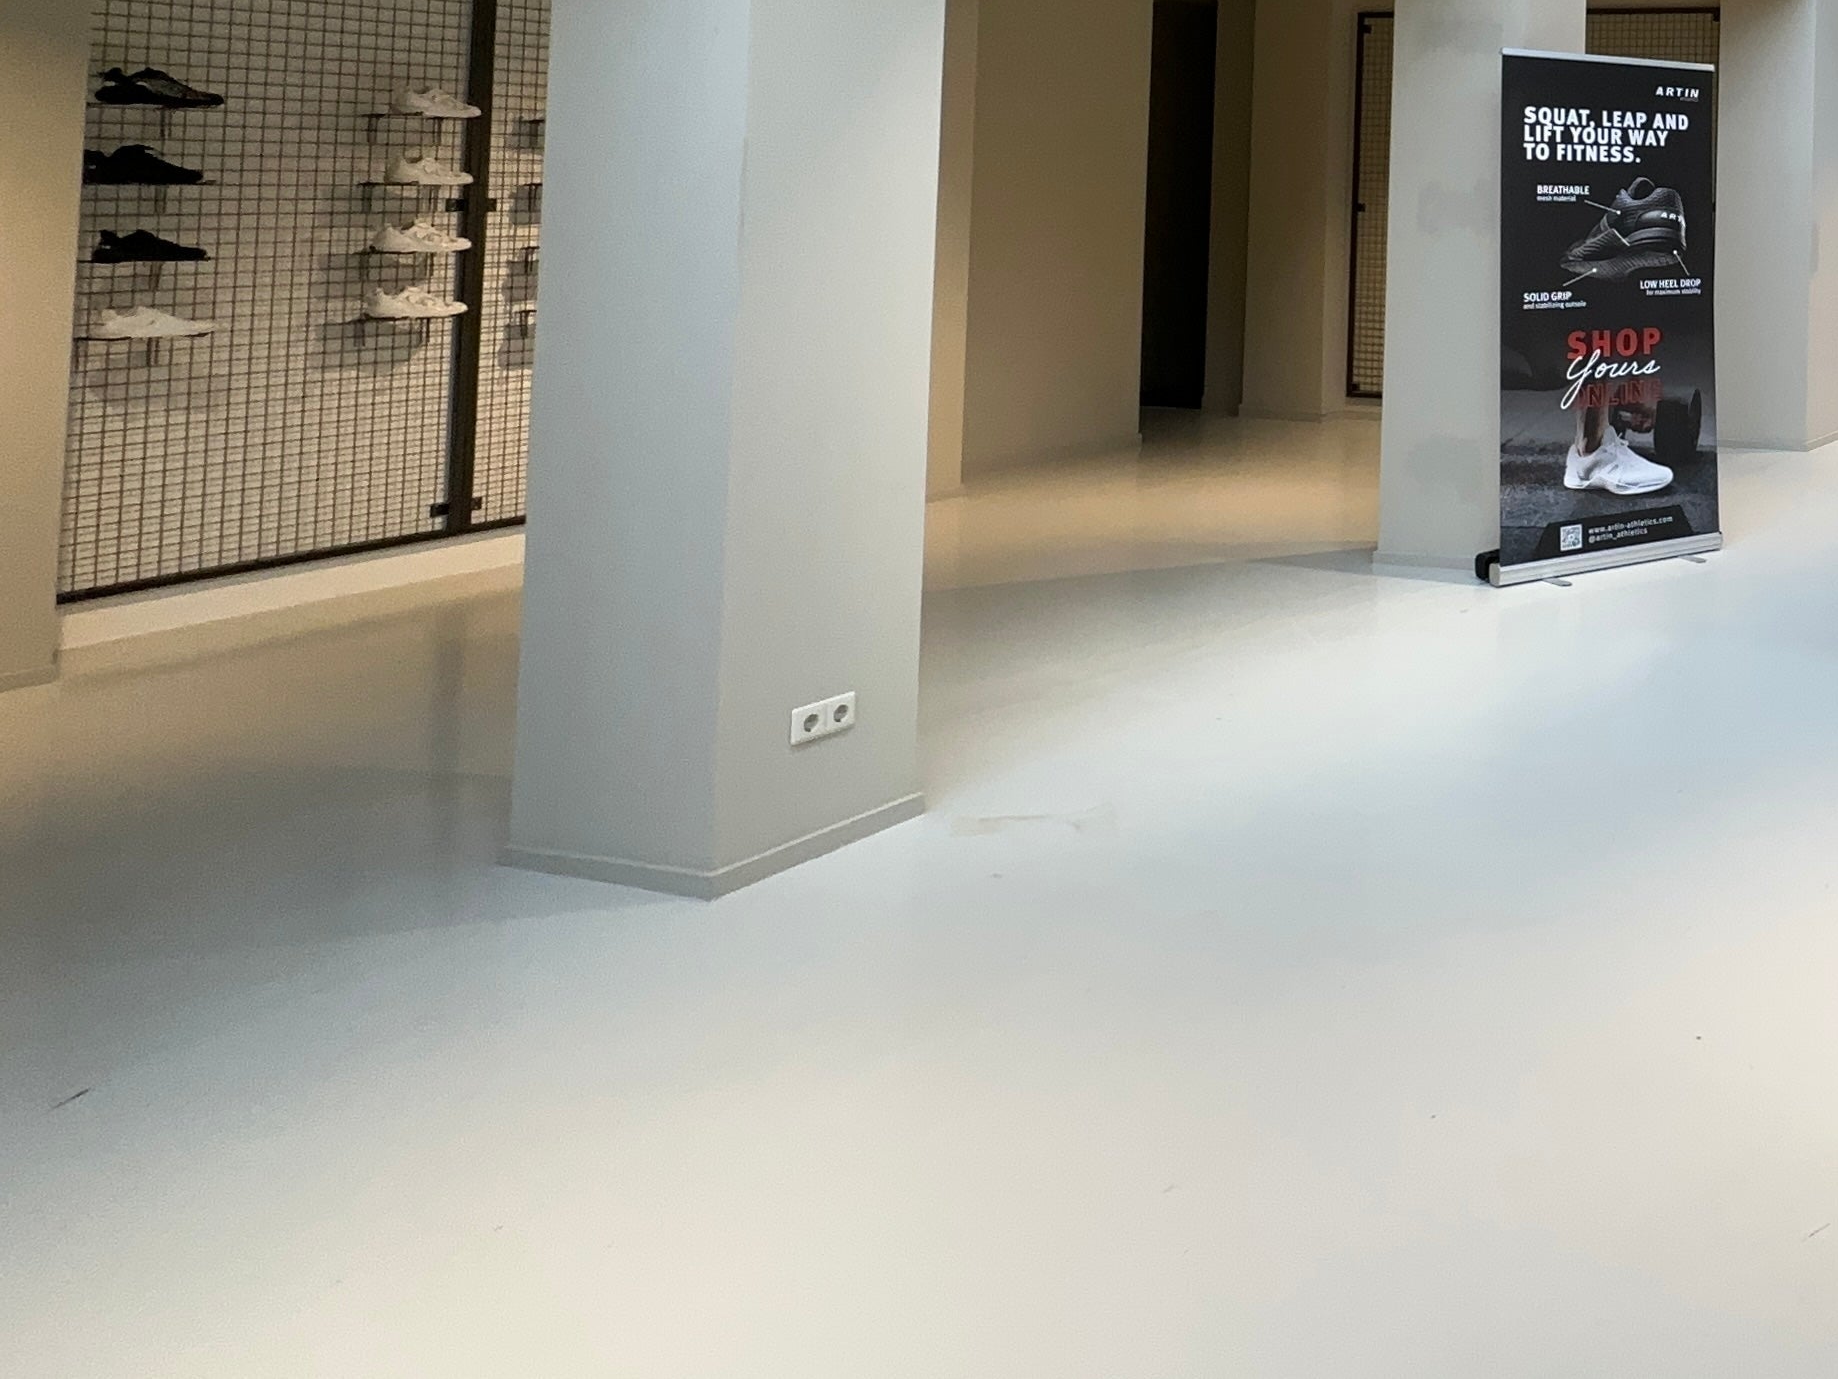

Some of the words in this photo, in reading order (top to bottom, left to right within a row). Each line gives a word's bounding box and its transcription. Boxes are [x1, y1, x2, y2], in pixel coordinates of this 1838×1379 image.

[1655, 86, 1700, 98] ARTIN
[1523, 106, 1595, 128] SQUAT,
[1602, 110, 1648, 129] LEAP
[1652, 113, 1689, 130] AND
[1523, 124, 1564, 143] LIFT
[1570, 127, 1623, 145] YOUR
[1628, 129, 1669, 147] WAY
[1523, 142, 1550, 161] TO
[1556, 144, 1641, 163] FITNESS.
[1536, 184, 1590, 195] BREATHABLE
[1639, 279, 1658, 290] LOW
[1658, 278, 1679, 289] HEEL
[1680, 278, 1702, 288] DROP
[1523, 292, 1550, 303] SOLID
[1550, 290, 1573, 302] GRIP
[1567, 328, 1661, 359] SHOP
